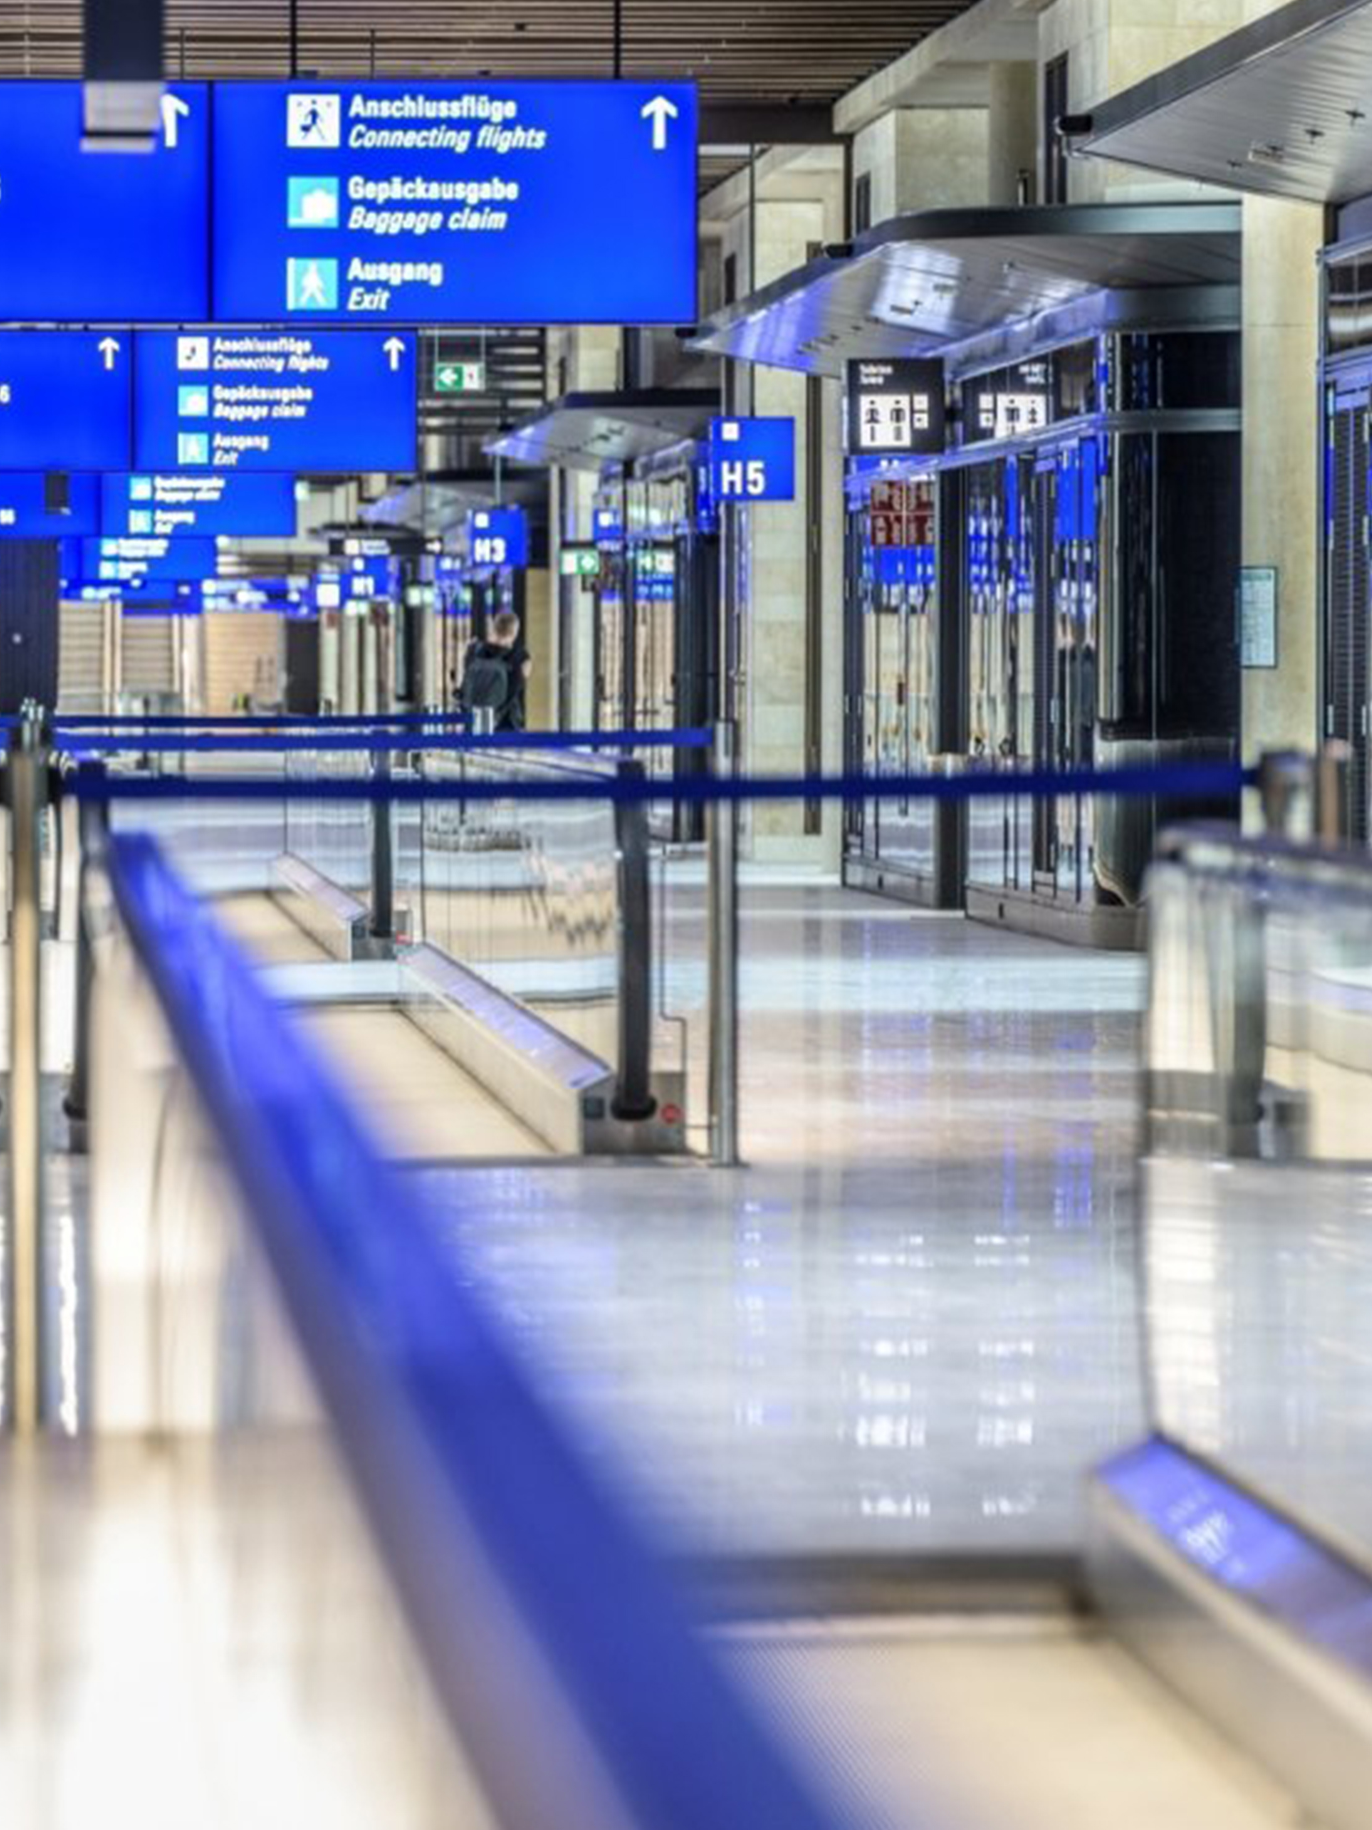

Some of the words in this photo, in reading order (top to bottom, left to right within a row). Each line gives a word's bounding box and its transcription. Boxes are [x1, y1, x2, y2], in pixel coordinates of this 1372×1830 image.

[348, 94, 516, 123] Anschlussflüge
[348, 124, 471, 154] Connecting
[476, 124, 547, 154] flights
[348, 174, 519, 206] Gepäckausgabe
[348, 206, 443, 235] Baggage
[447, 206, 508, 231] claim
[348, 257, 444, 287] Ausgang
[348, 287, 390, 311] Exit
[721, 460, 766, 496] H5
[474, 537, 507, 564] H3
